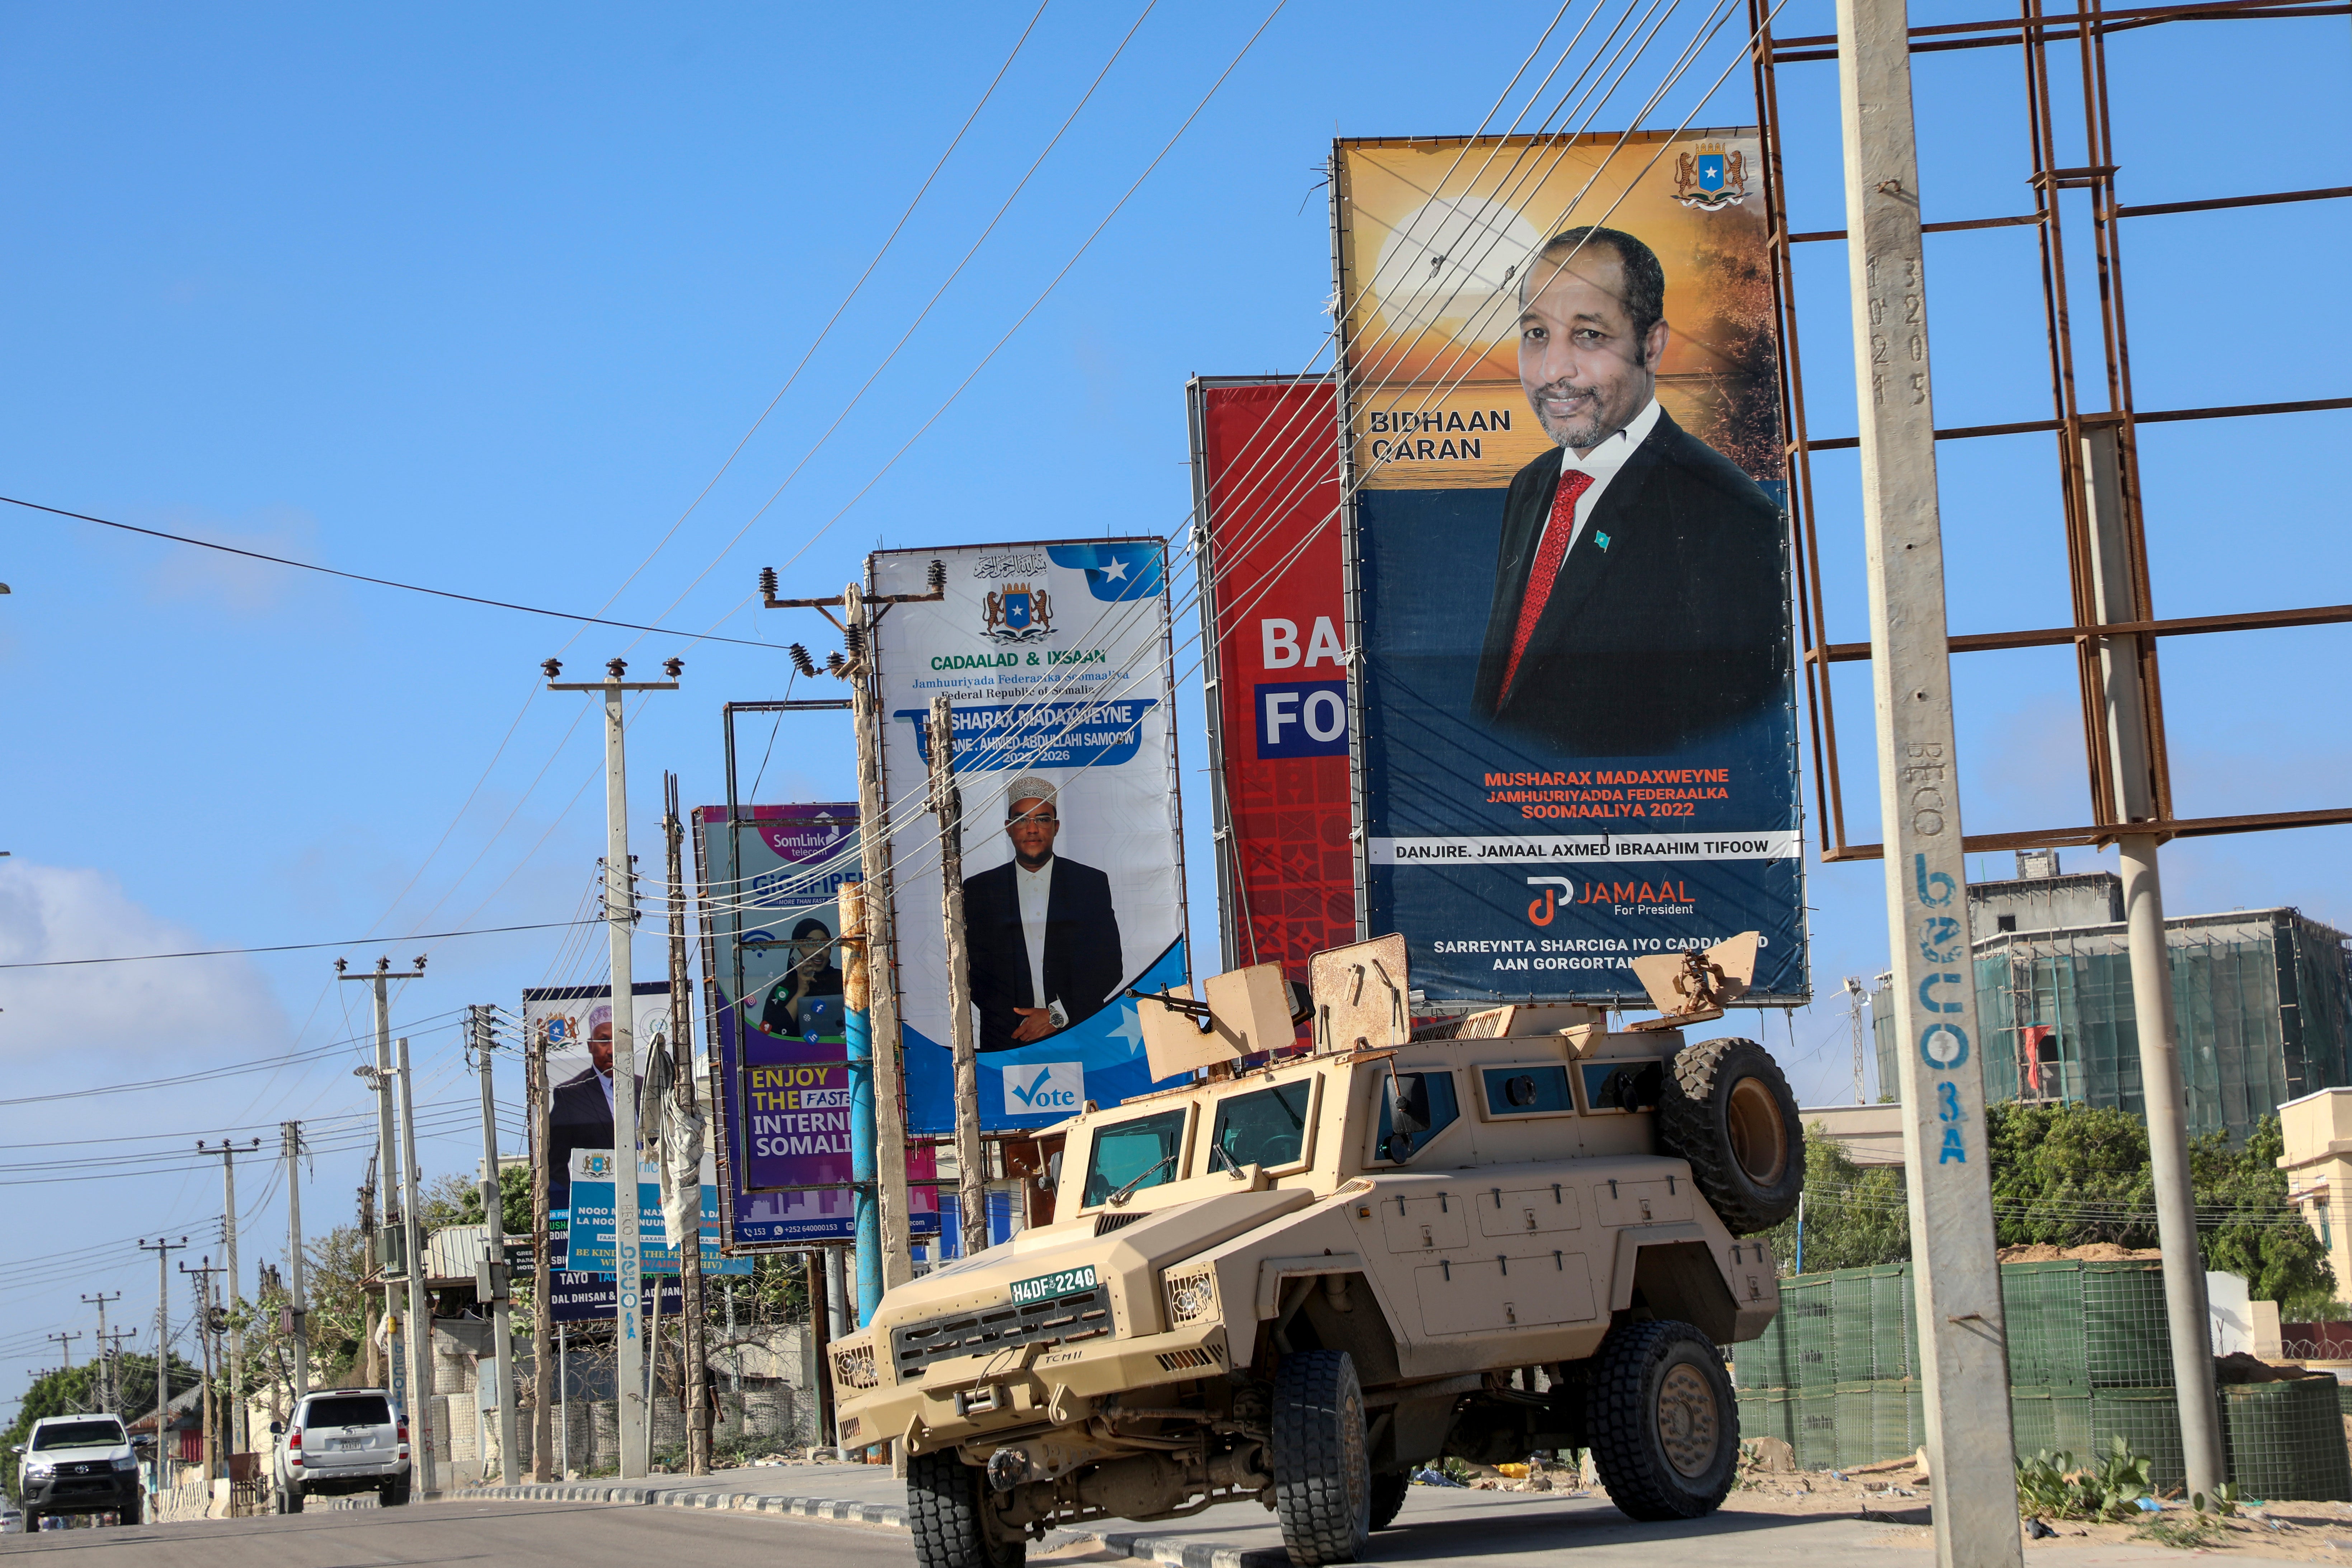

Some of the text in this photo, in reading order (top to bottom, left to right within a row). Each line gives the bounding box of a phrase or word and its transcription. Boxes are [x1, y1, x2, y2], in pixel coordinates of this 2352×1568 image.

[1370, 409, 1511, 433] BIDHAAN
[1371, 439, 1482, 465] QARAN
[931, 650, 1106, 670] CADAALAD & IXSAAN
[912, 676, 994, 689] Jamhuuriyada
[998, 673, 1061, 684] Federaalka
[941, 684, 1095, 700] Federal Republic of Somalia
[923, 705, 1133, 731] SHARAX MADAXWEYNE
[980, 736, 1021, 751] AHMED
[1022, 732, 1082, 749] ABDULLAHI
[1003, 750, 1070, 764] 2022 2026
[1485, 768, 1729, 787] MUSHARAX MADAXWEYNE
[1486, 787, 1729, 804] JAMHUURIYADDA FEDERAALKA
[1521, 802, 1695, 819] SOOMAALIYA 2022
[773, 833, 826, 847] SomLink
[1396, 839, 1769, 858] DANJIRE. JAMAAL AXMED IBRAAHIM TIFOOW
[791, 847, 827, 856] telecom
[1577, 881, 1695, 904] JAMAAL
[1614, 903, 1694, 915] For President
[1434, 937, 1769, 953] SARREYNTA SHARCIGA IYO CADDAD
[1492, 957, 1529, 971] AAN
[752, 1068, 828, 1088] ENJOY
[752, 1090, 800, 1111] THE
[753, 1111, 851, 1135] INTERN
[578, 1207, 608, 1215] NOQO
[802, 1224, 838, 1232] 640000153
[576, 1248, 589, 1257] BE
[560, 1272, 589, 1285] TAYO
[1012, 1268, 1095, 1303] H4DF 2240
[551, 1294, 570, 1304] DAL
[571, 1291, 607, 1303] DHISAN
[608, 1291, 616, 1300] &
